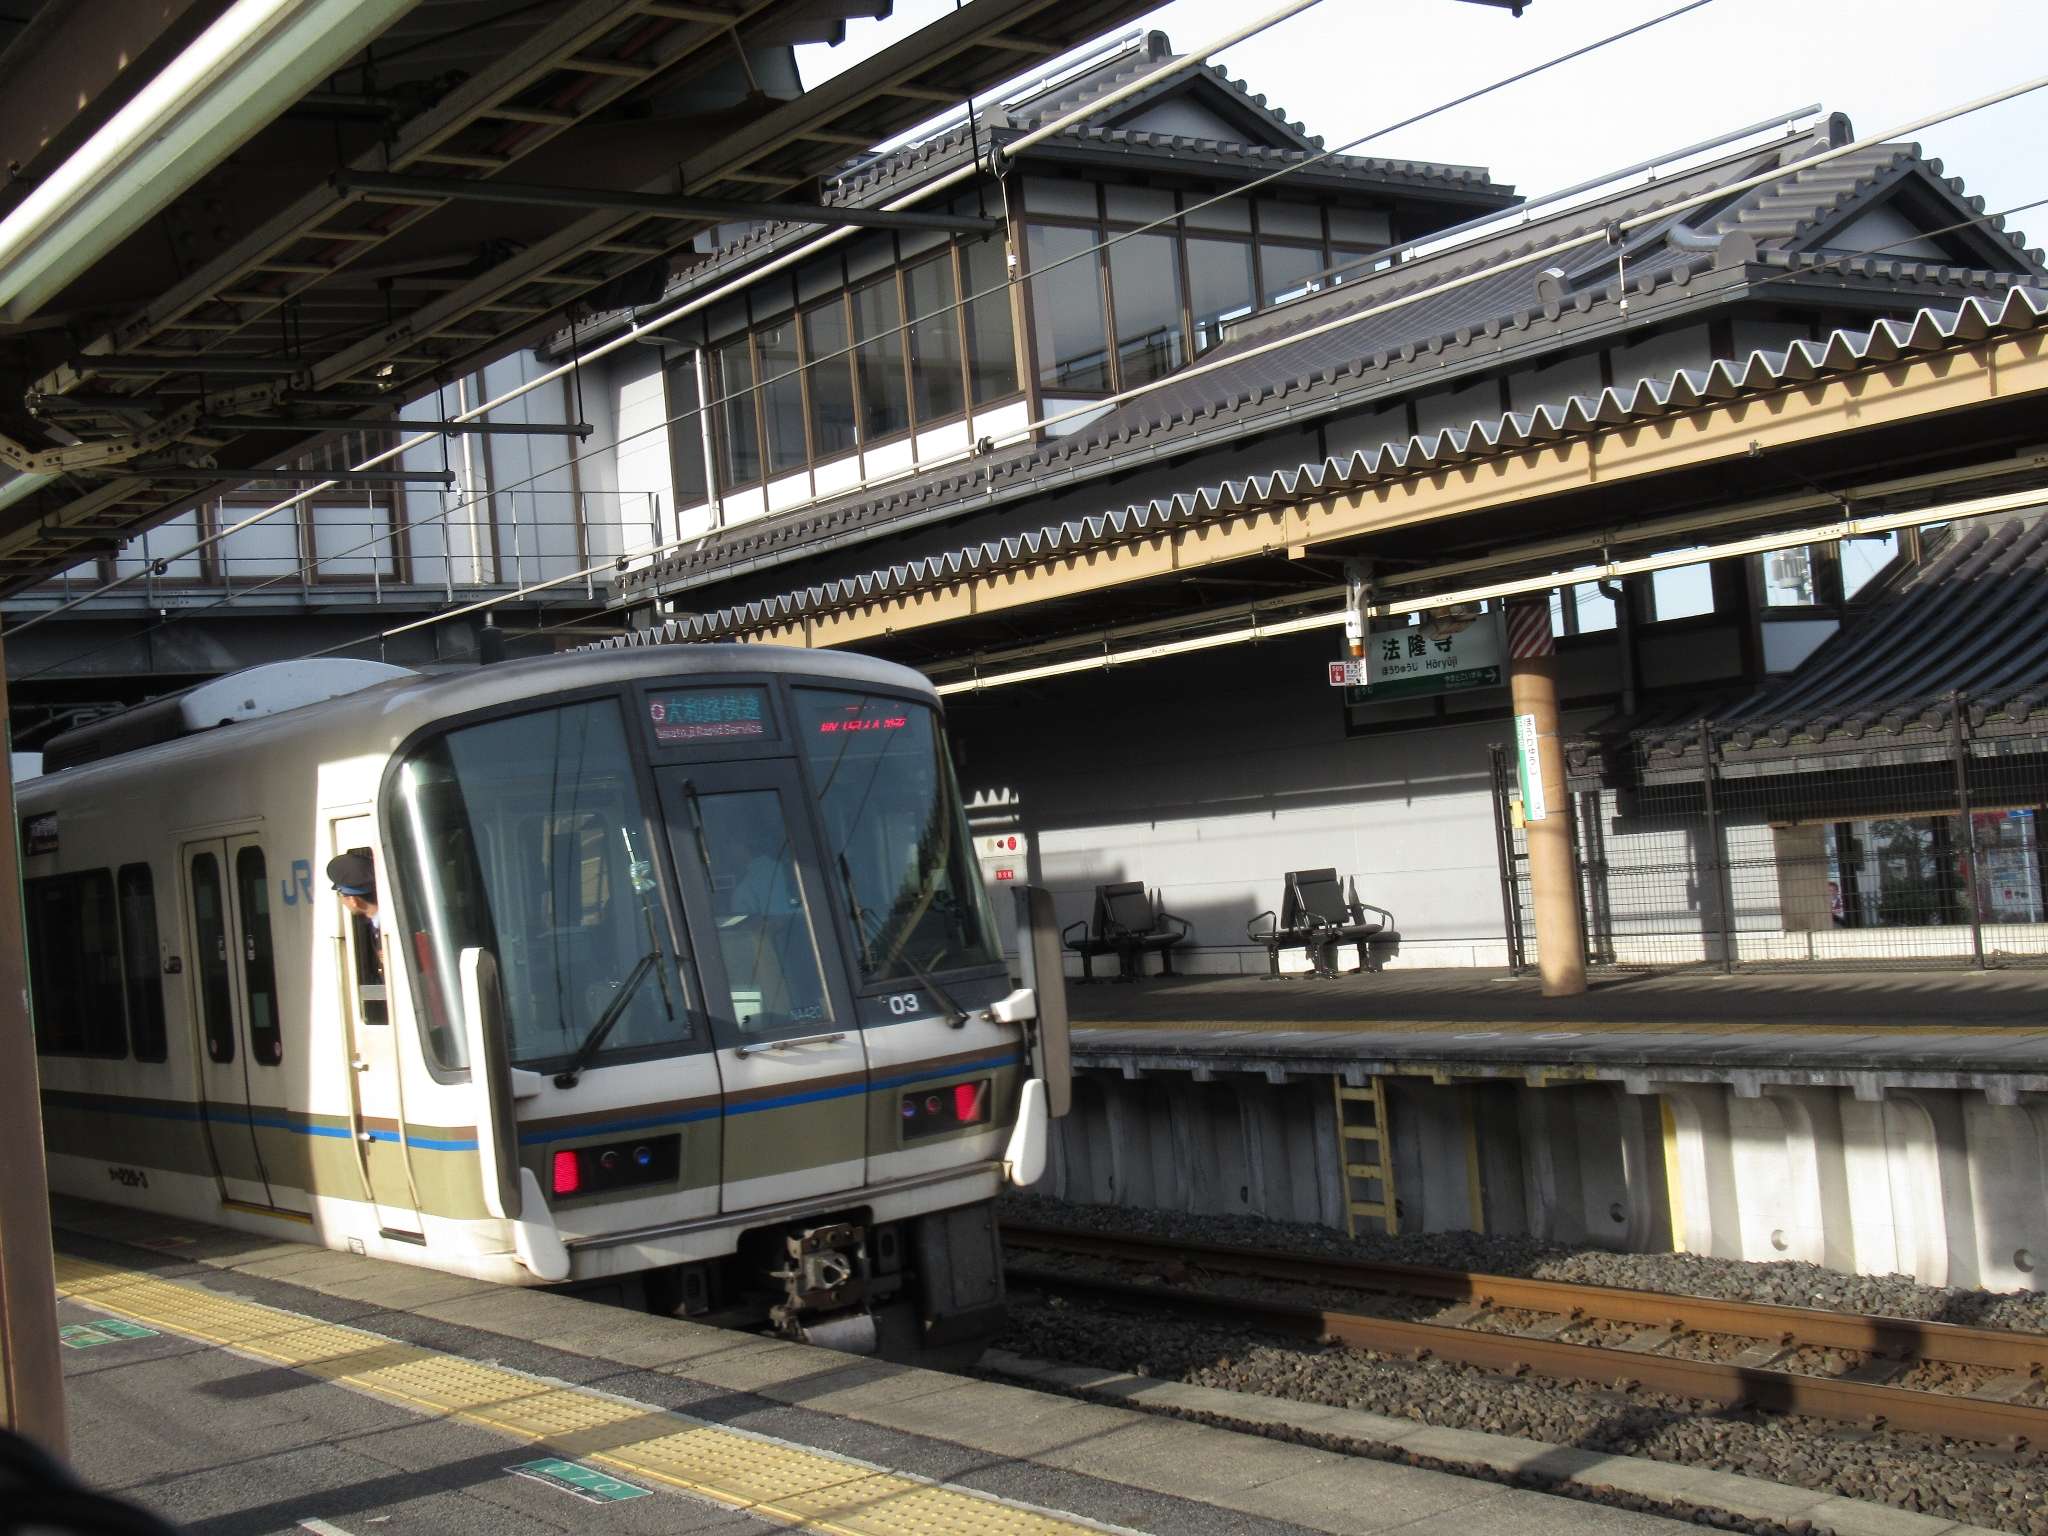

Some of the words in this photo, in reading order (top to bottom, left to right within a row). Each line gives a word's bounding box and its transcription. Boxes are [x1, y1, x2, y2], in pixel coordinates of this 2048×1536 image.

[1382, 634, 1453, 661] 法隆寺
[1381, 662, 1418, 676] ほうりゅうじ
[282, 859, 314, 906] JR
[889, 993, 919, 1014] 03
